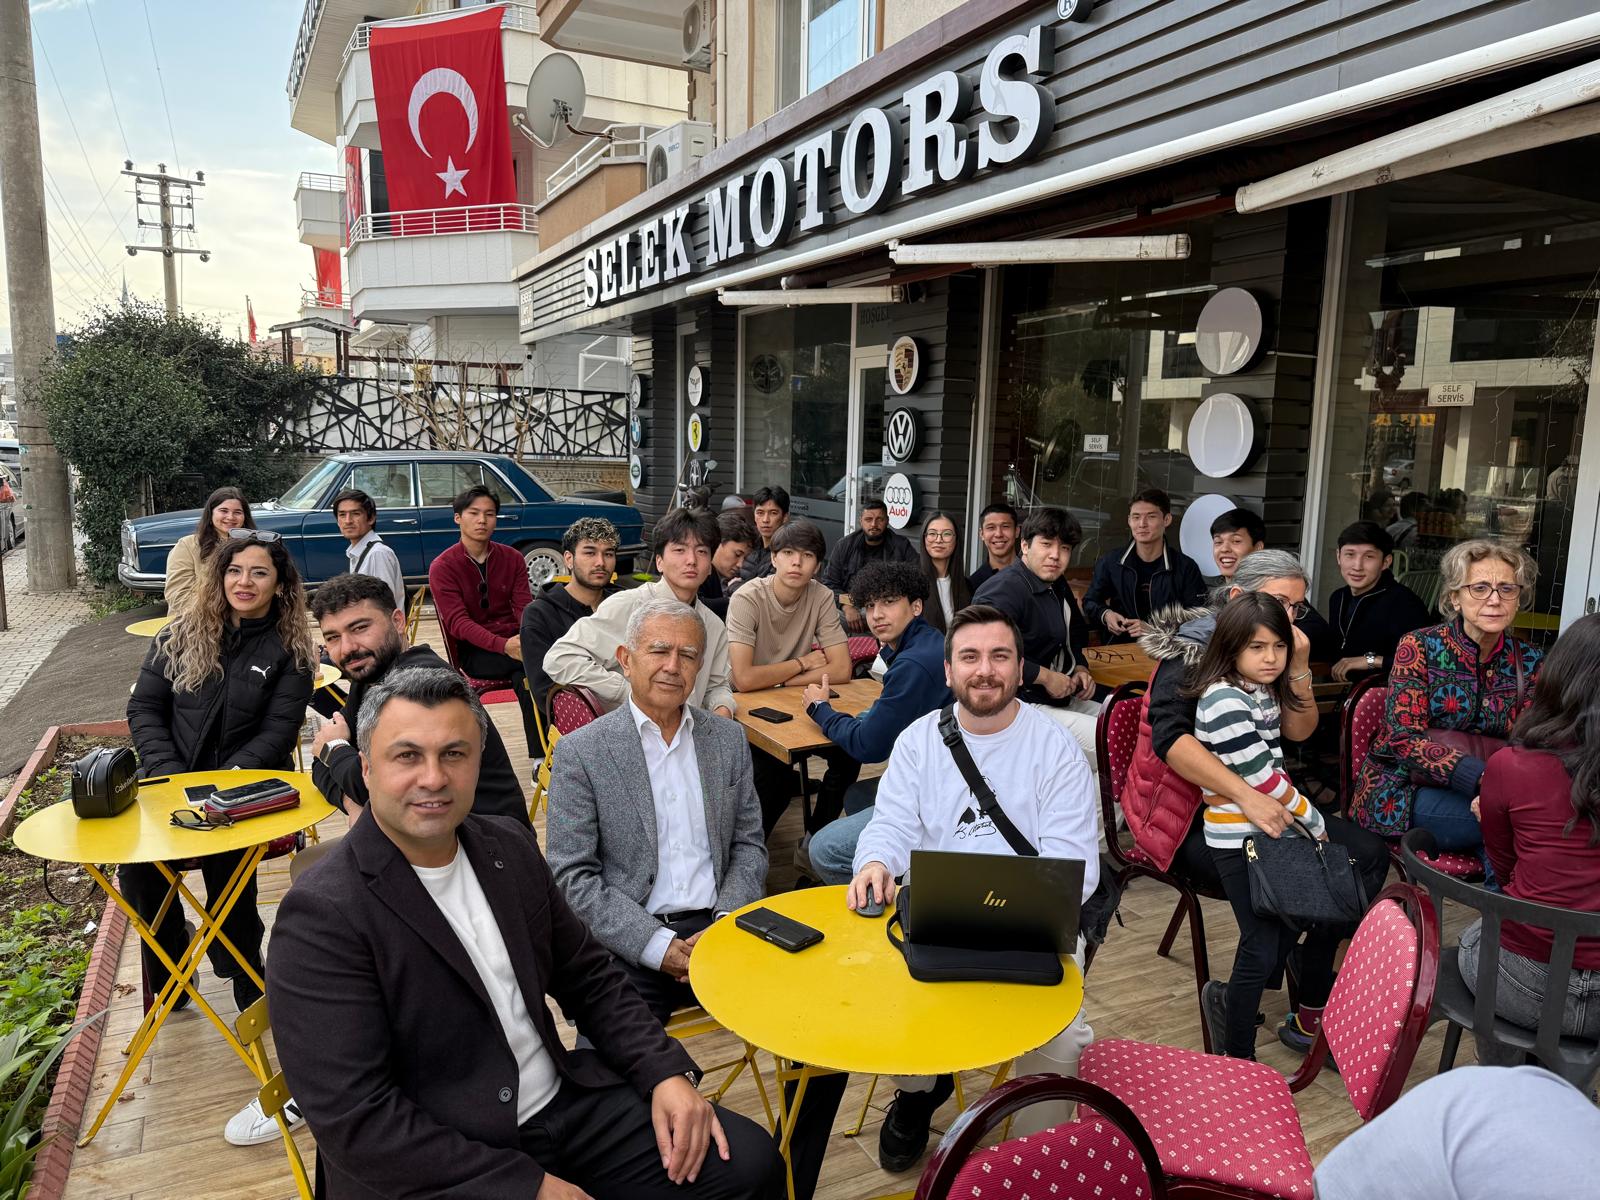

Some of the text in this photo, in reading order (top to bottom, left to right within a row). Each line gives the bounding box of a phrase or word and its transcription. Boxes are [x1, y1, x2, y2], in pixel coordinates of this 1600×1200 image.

[583, 203, 695, 308] SELEK
[704, 24, 1050, 266] MOTORS
[1442, 384, 1462, 393] SELF
[1437, 392, 1465, 403] SERVİS
[888, 504, 908, 517] Audi
